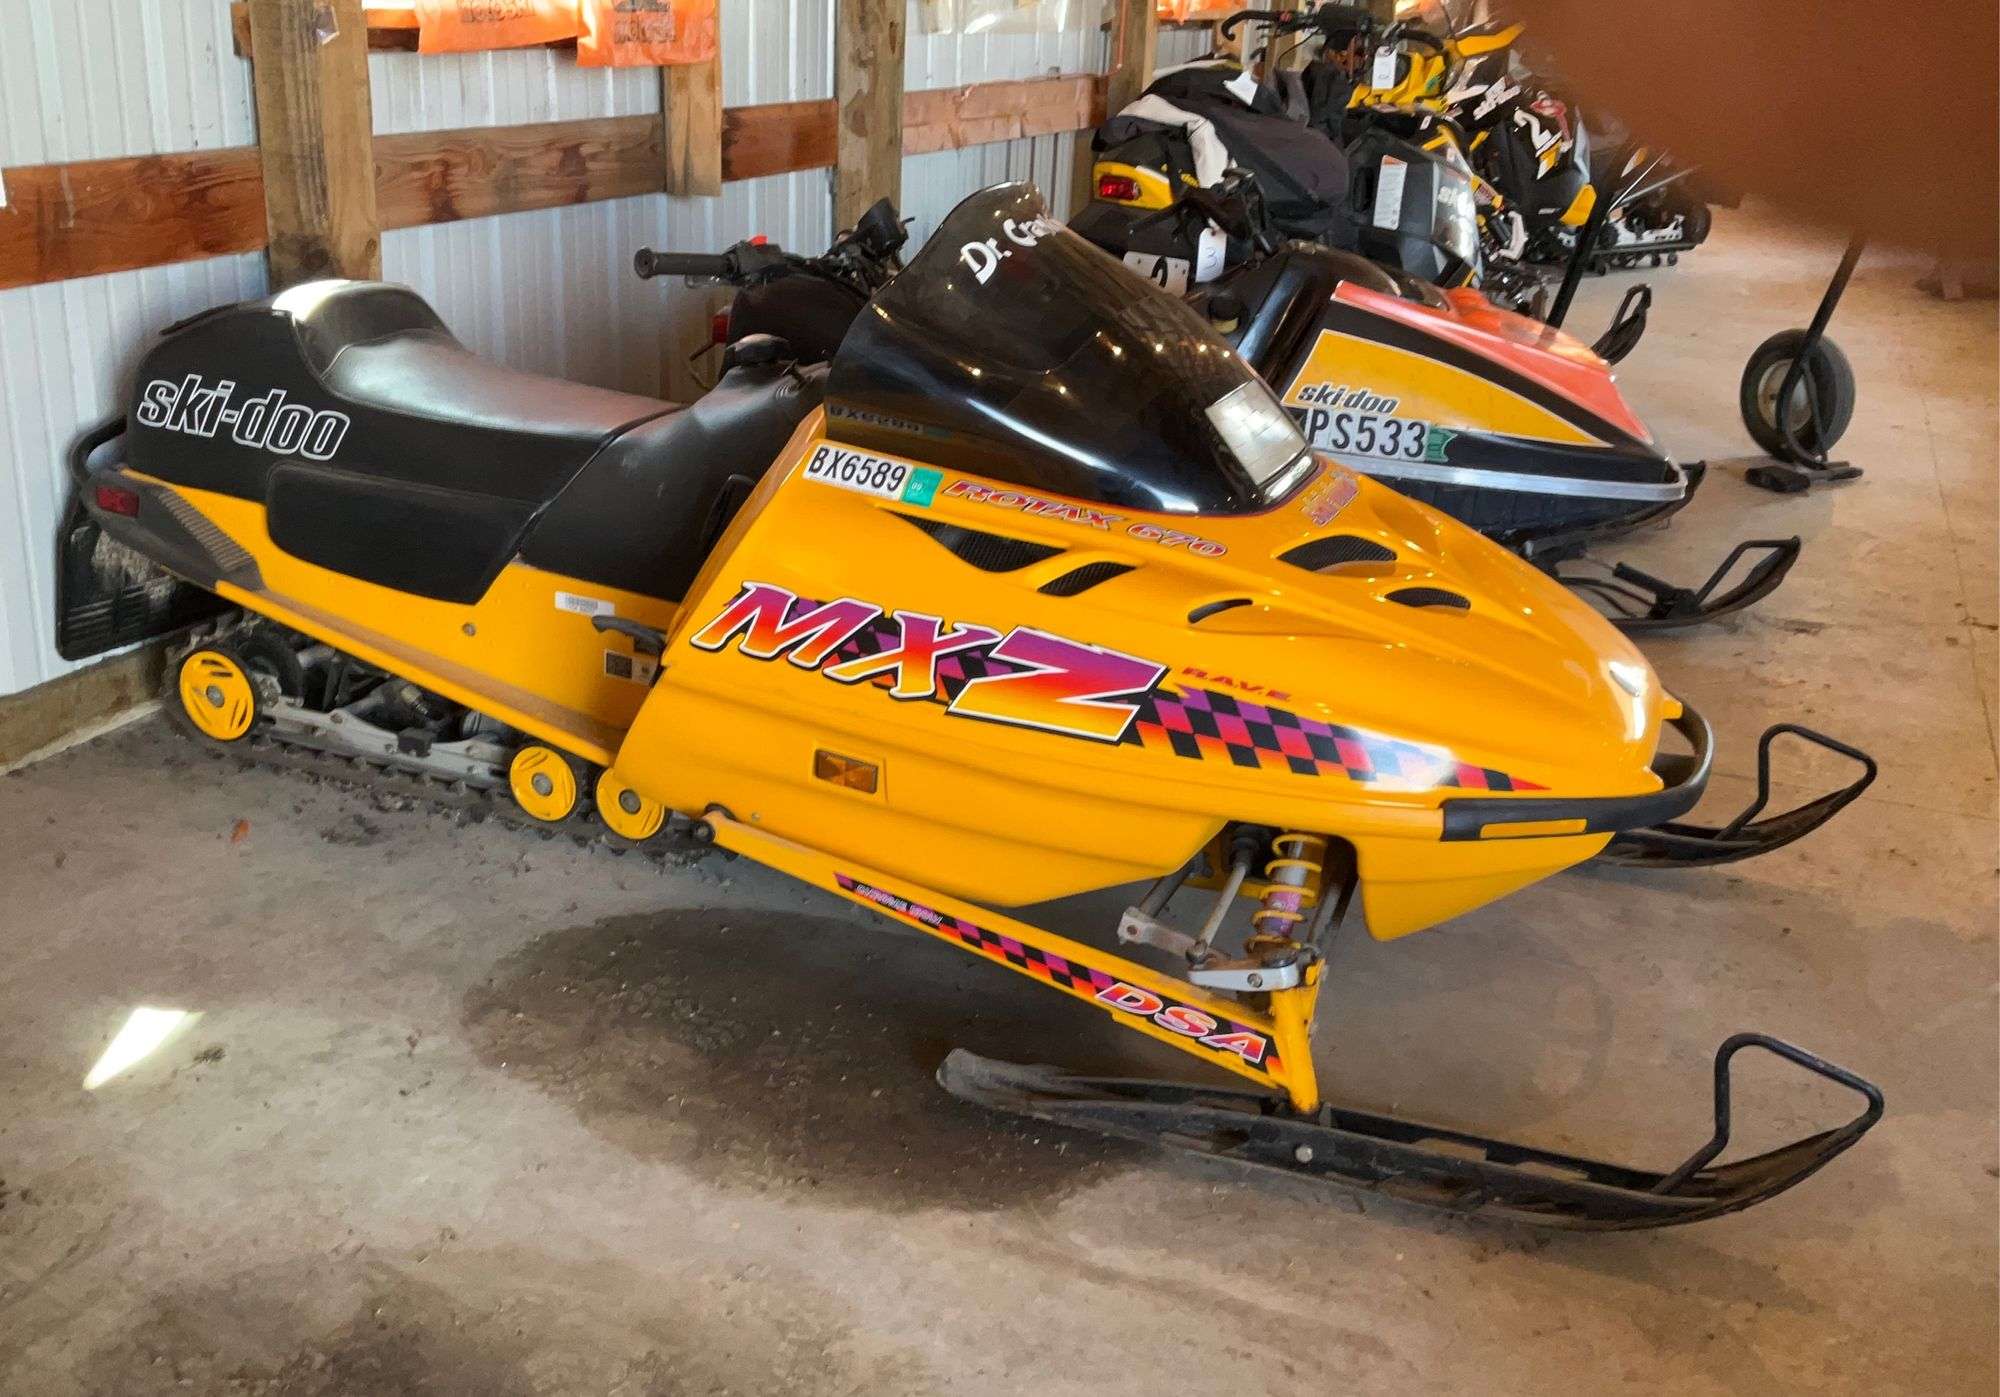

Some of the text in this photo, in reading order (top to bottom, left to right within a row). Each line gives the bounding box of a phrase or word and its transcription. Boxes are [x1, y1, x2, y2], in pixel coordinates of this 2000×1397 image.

[960, 237, 1013, 285] Dr.
[136, 373, 351, 461] ski-doo
[1307, 408, 1426, 458] PS533
[808, 446, 907, 492] BX6589
[942, 478, 1228, 558] ROTAX 670
[690, 577, 1169, 743] MXZ
[1094, 981, 1267, 1064] DSA
